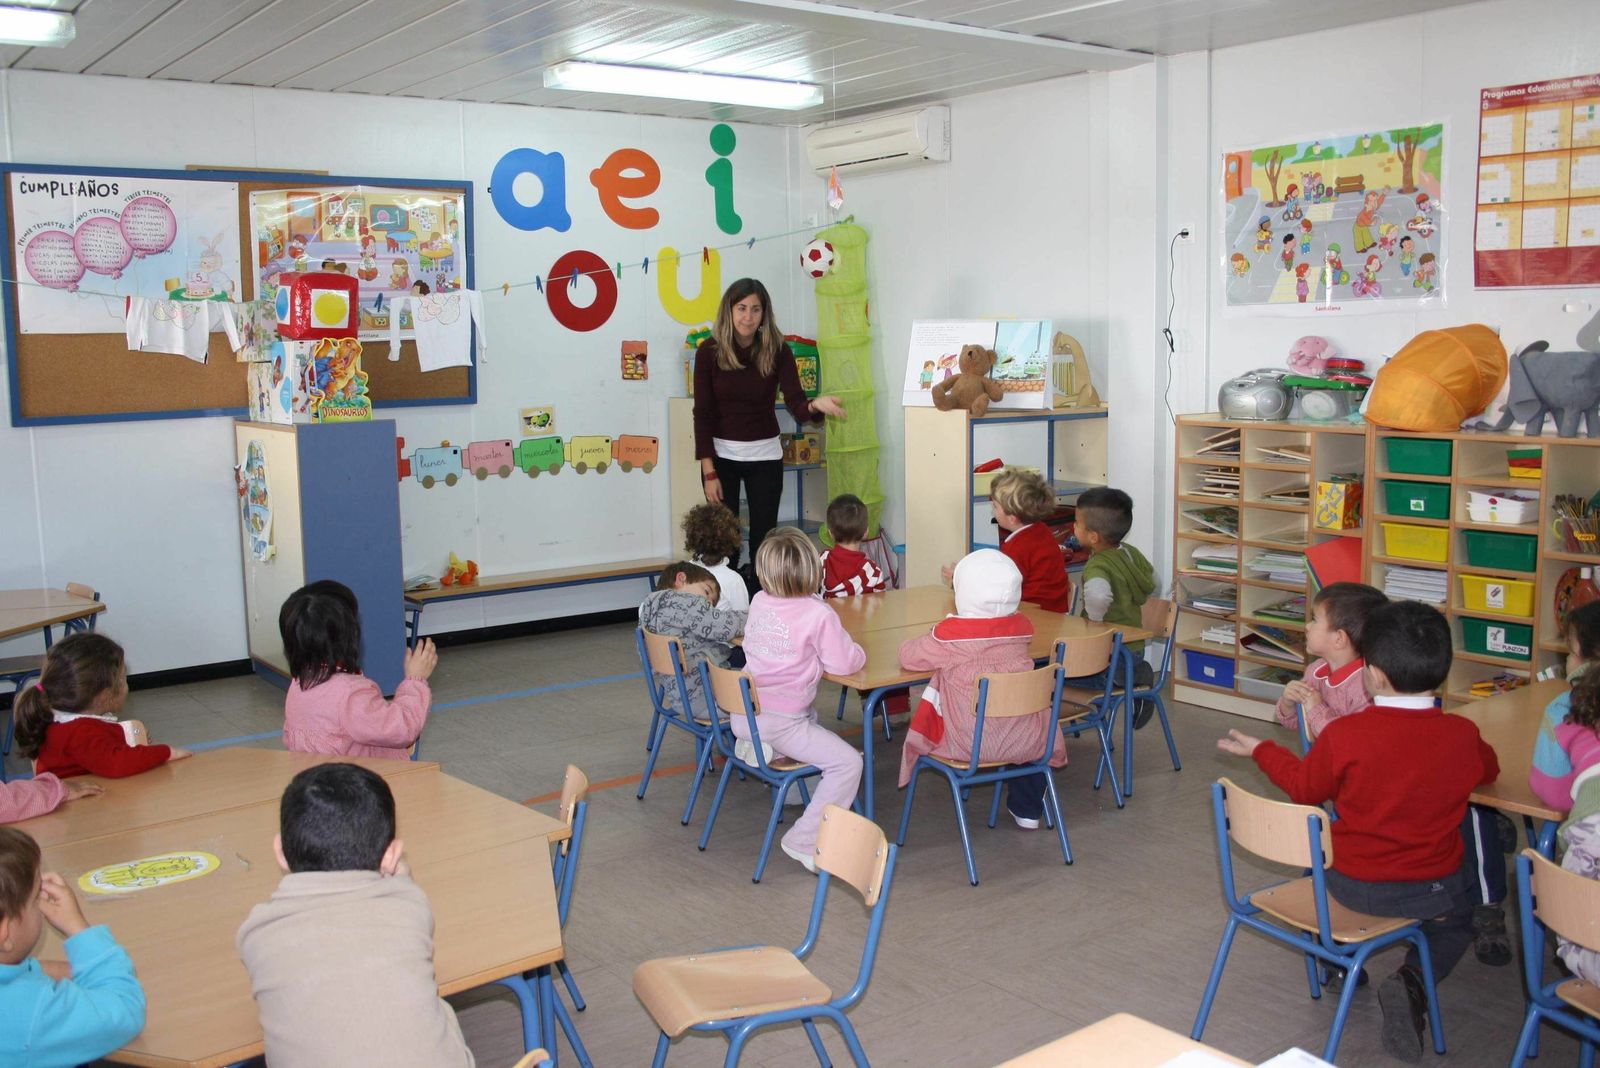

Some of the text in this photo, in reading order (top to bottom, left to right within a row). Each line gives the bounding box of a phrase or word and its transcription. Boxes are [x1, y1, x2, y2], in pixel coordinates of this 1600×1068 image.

[490, 124, 742, 234] a e i
[321, 406, 369, 417] DINOSAURIOS
[473, 447, 503, 461] martes
[580, 447, 605, 459] jueves
[420, 454, 446, 468] lunes
